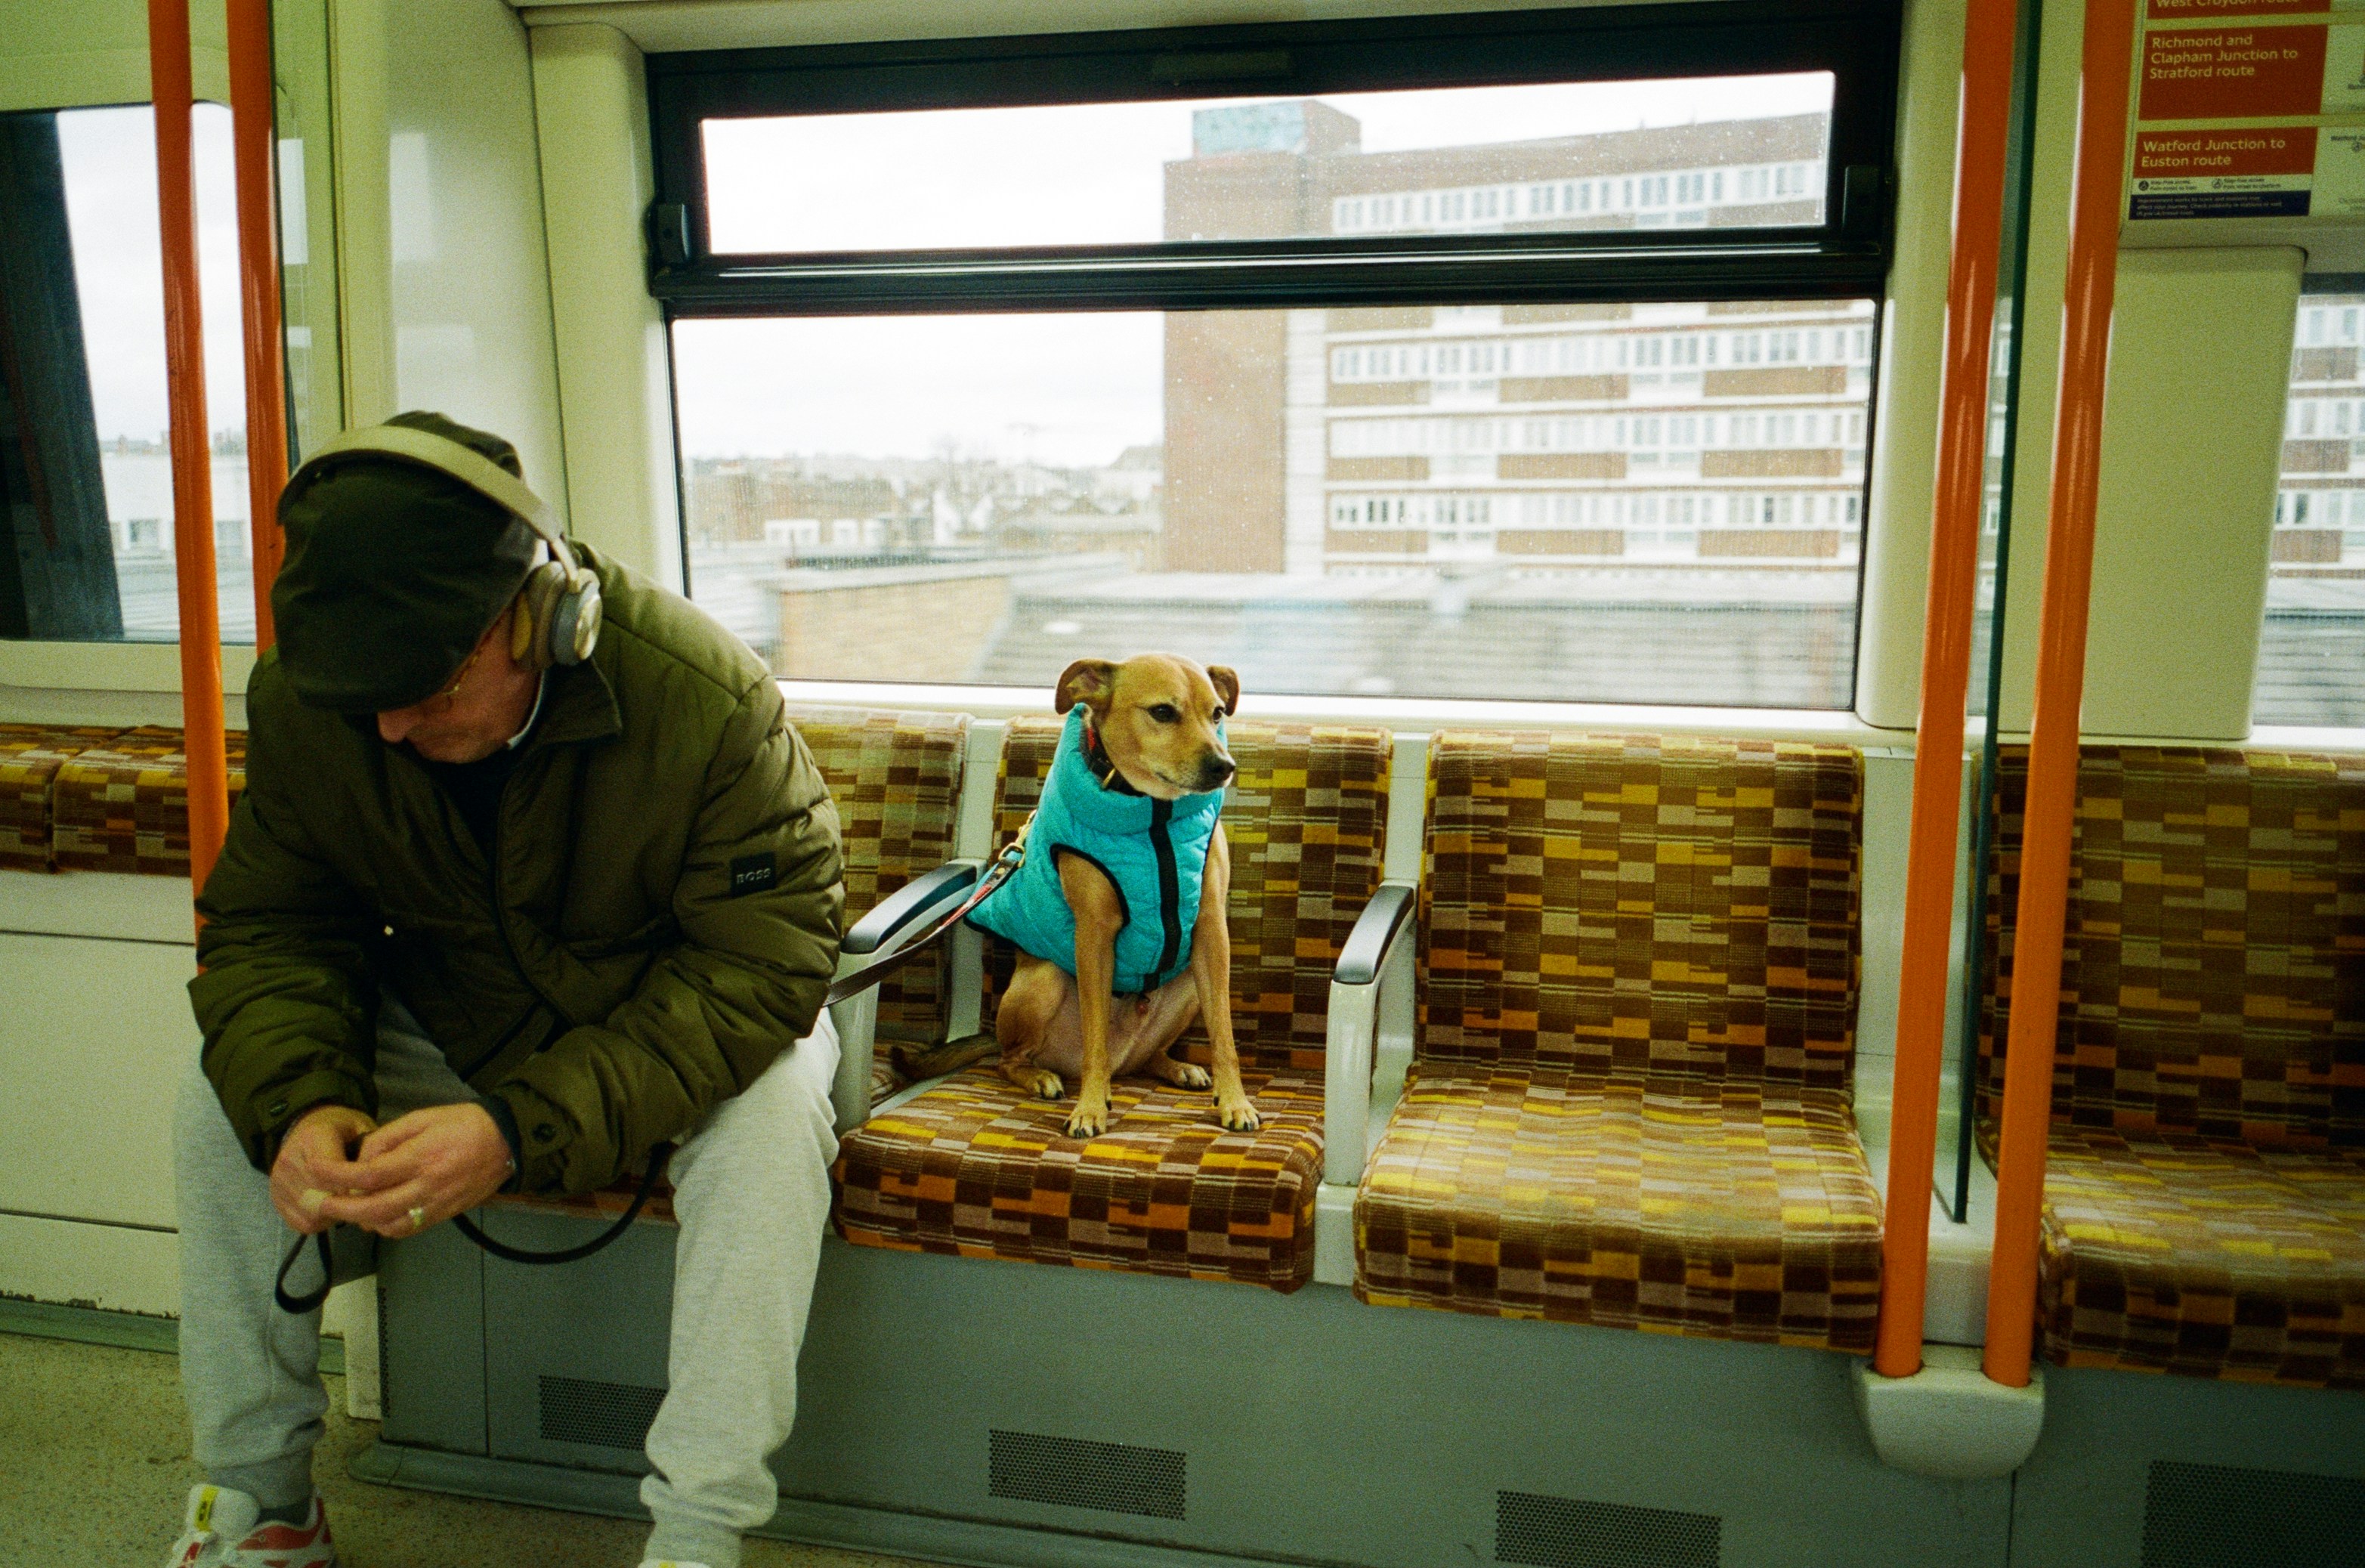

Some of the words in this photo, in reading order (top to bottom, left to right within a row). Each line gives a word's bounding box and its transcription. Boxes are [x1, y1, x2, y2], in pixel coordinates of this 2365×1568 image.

[2153, 36, 2222, 48] Richmond
[2226, 35, 2252, 45] and
[2151, 51, 2212, 65] Clapham
[2217, 49, 2278, 61] Junction
[2283, 49, 2298, 59] to
[2150, 66, 2212, 79] Stratford
[2217, 65, 2255, 76] route
[2143, 140, 2200, 152] Watford
[2205, 139, 2265, 150] Junction
[2270, 139, 2286, 149] to
[2141, 156, 2189, 167] Euston
[2193, 155, 2231, 165] route
[737, 868, 771, 884] BOSS
